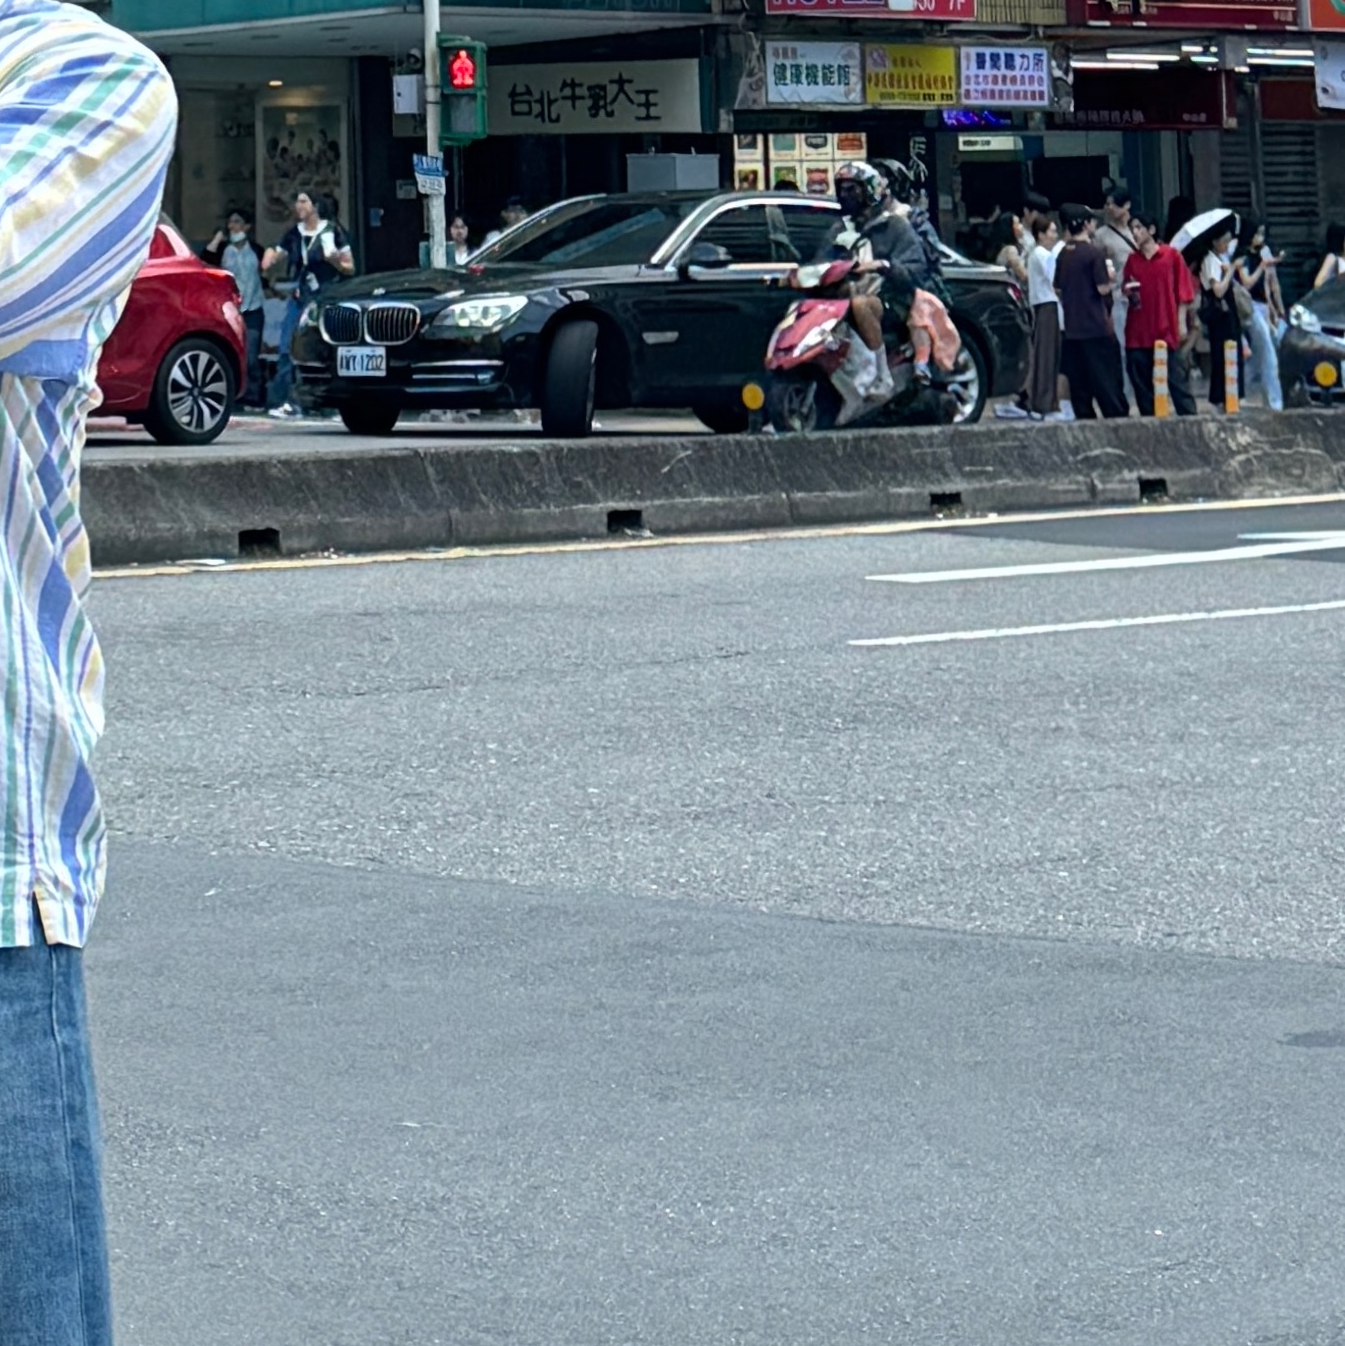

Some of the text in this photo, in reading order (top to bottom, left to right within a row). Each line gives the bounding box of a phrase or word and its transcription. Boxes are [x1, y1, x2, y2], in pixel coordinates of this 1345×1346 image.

[508, 71, 662, 125] 台北牛乳大王
